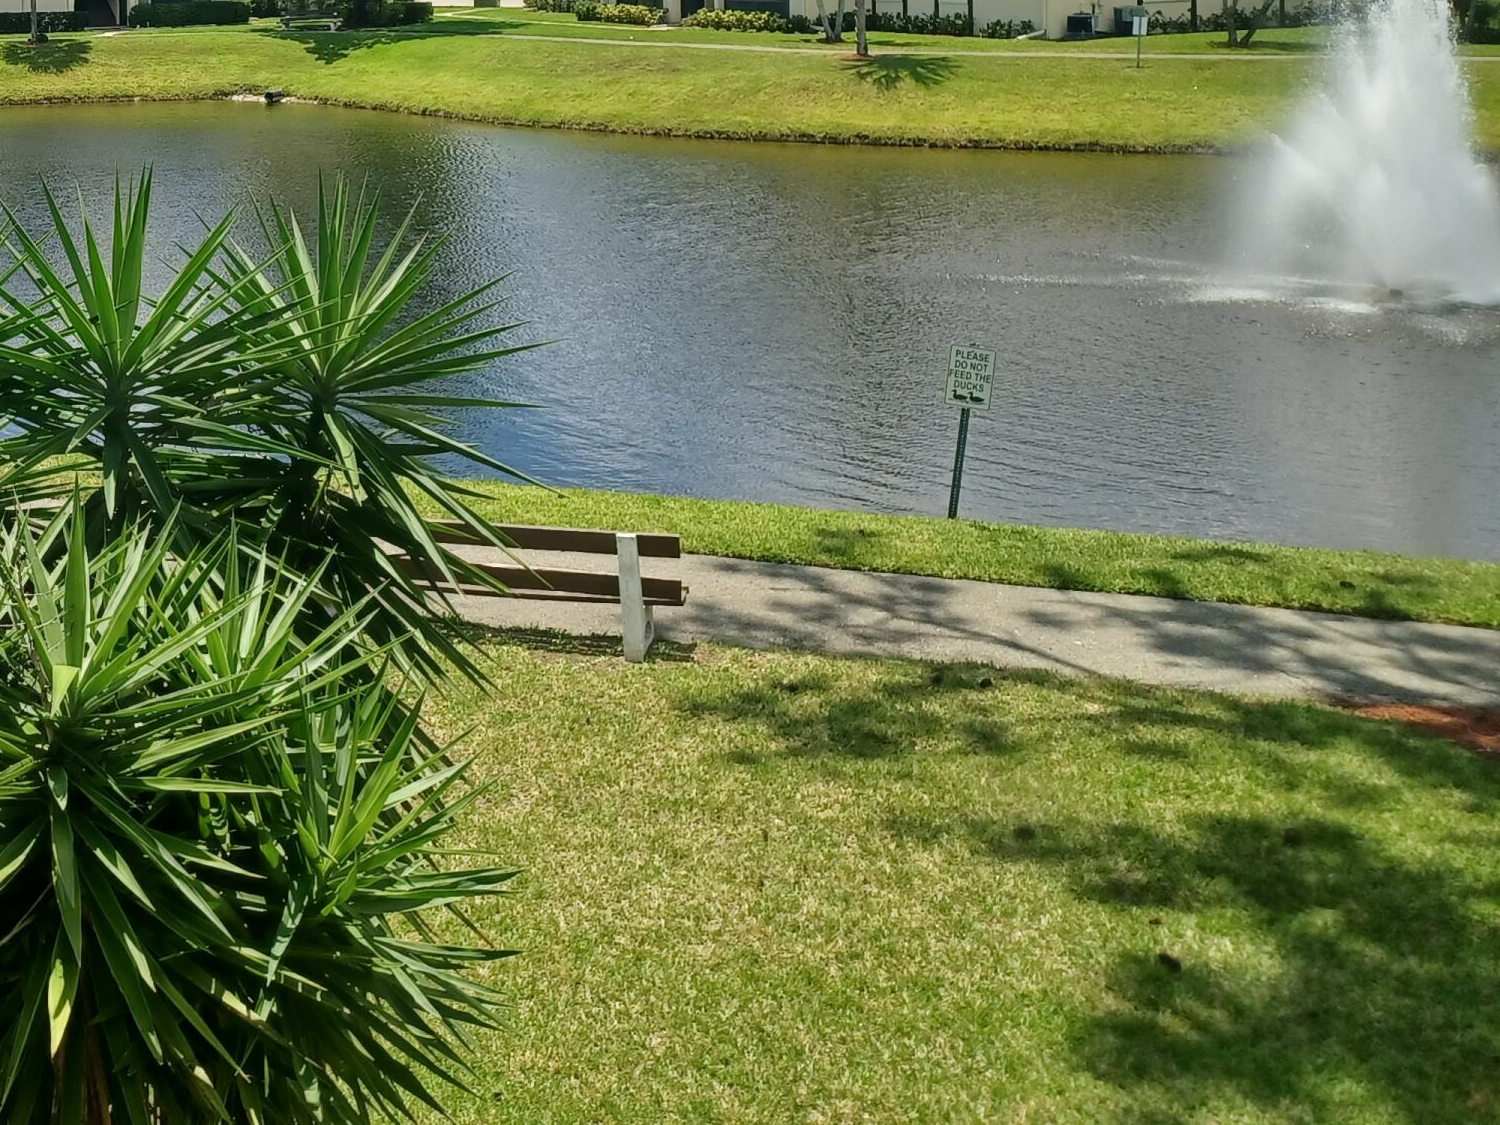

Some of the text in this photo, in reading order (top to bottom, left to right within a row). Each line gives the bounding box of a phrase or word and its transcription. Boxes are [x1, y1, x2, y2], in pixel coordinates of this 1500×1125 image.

[956, 349, 990, 362] PLEASE
[954, 360, 988, 372] DO NOT
[949, 369, 992, 384] FEED THE
[954, 380, 984, 392] DUCKS
